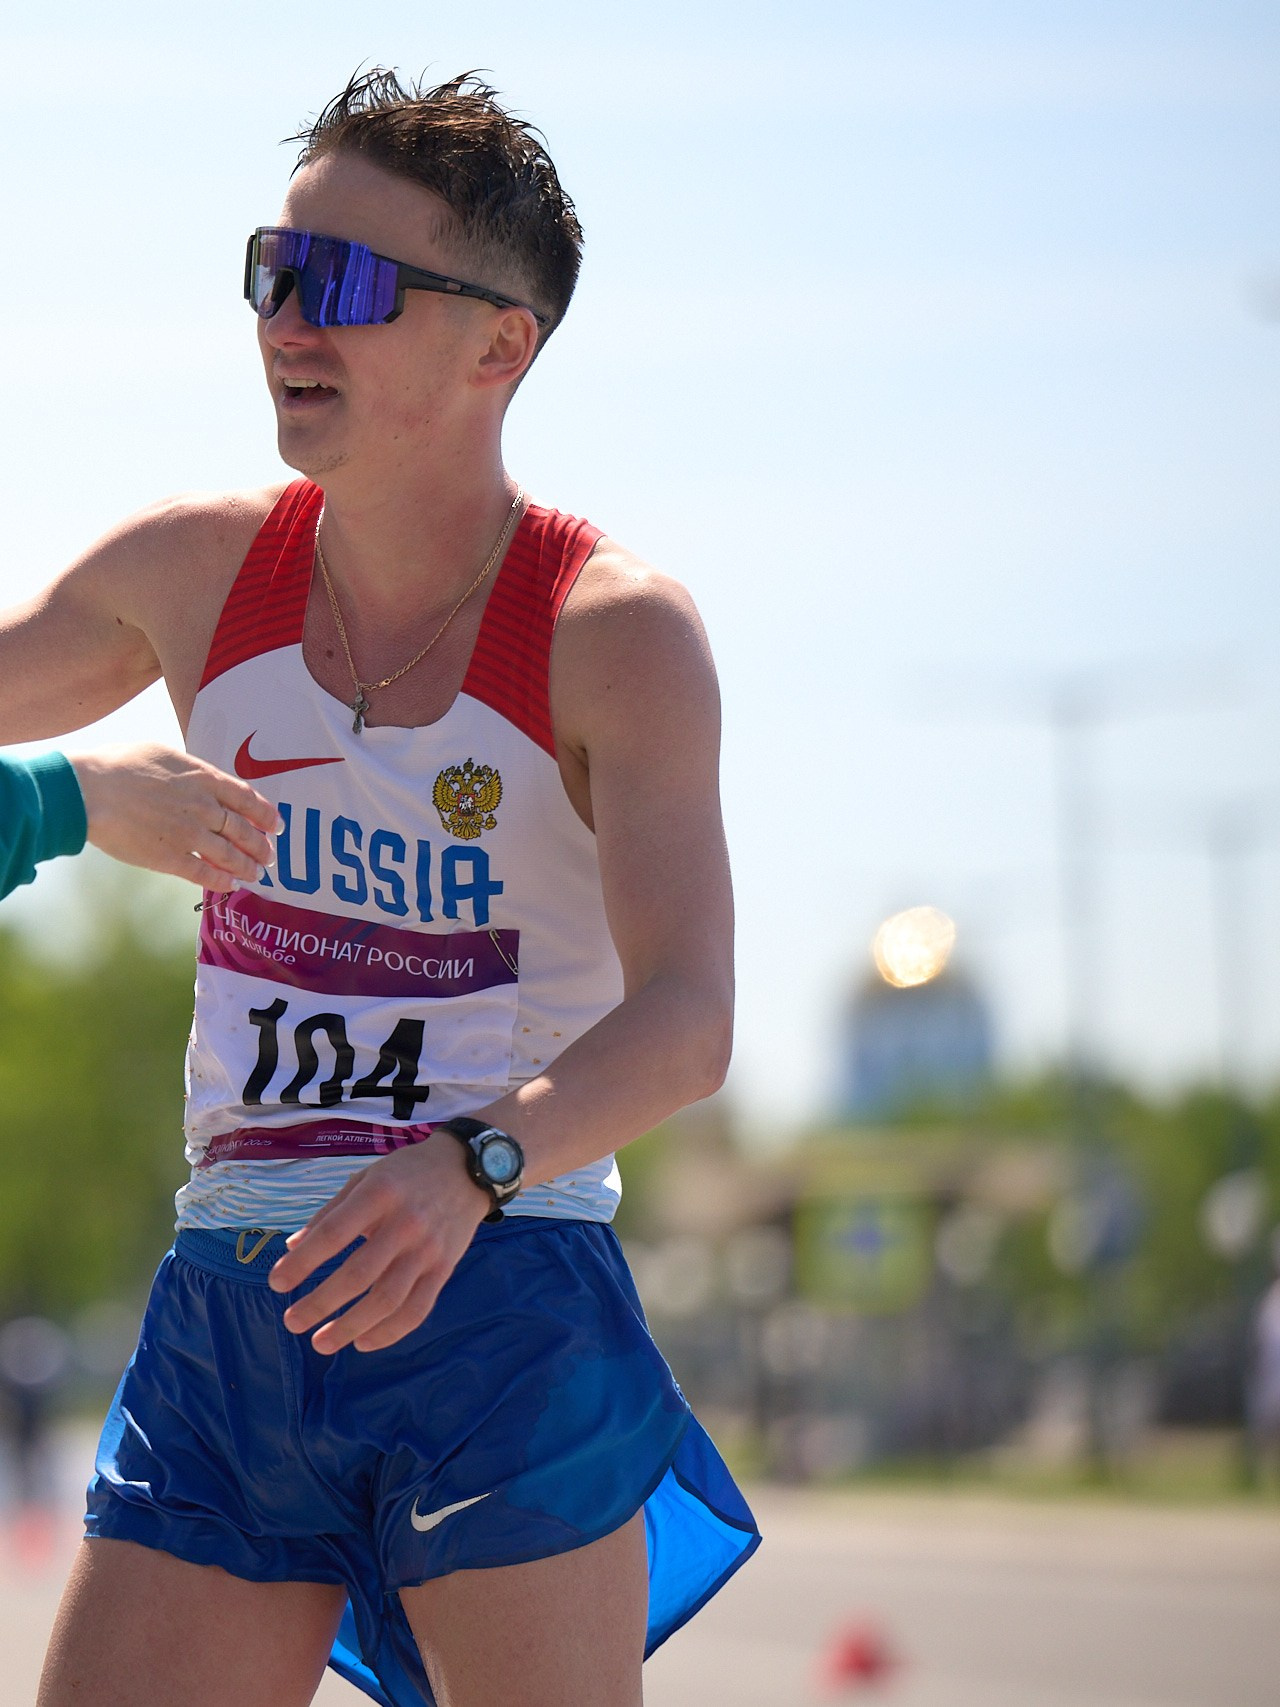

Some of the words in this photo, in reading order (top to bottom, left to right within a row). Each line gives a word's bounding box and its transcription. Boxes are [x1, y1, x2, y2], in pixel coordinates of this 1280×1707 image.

[258, 802, 504, 927] USSIA
[214, 905, 366, 963] ЧЕМПИОНАТ
[367, 947, 474, 979] РОССИИ
[242, 998, 430, 1120] 104
